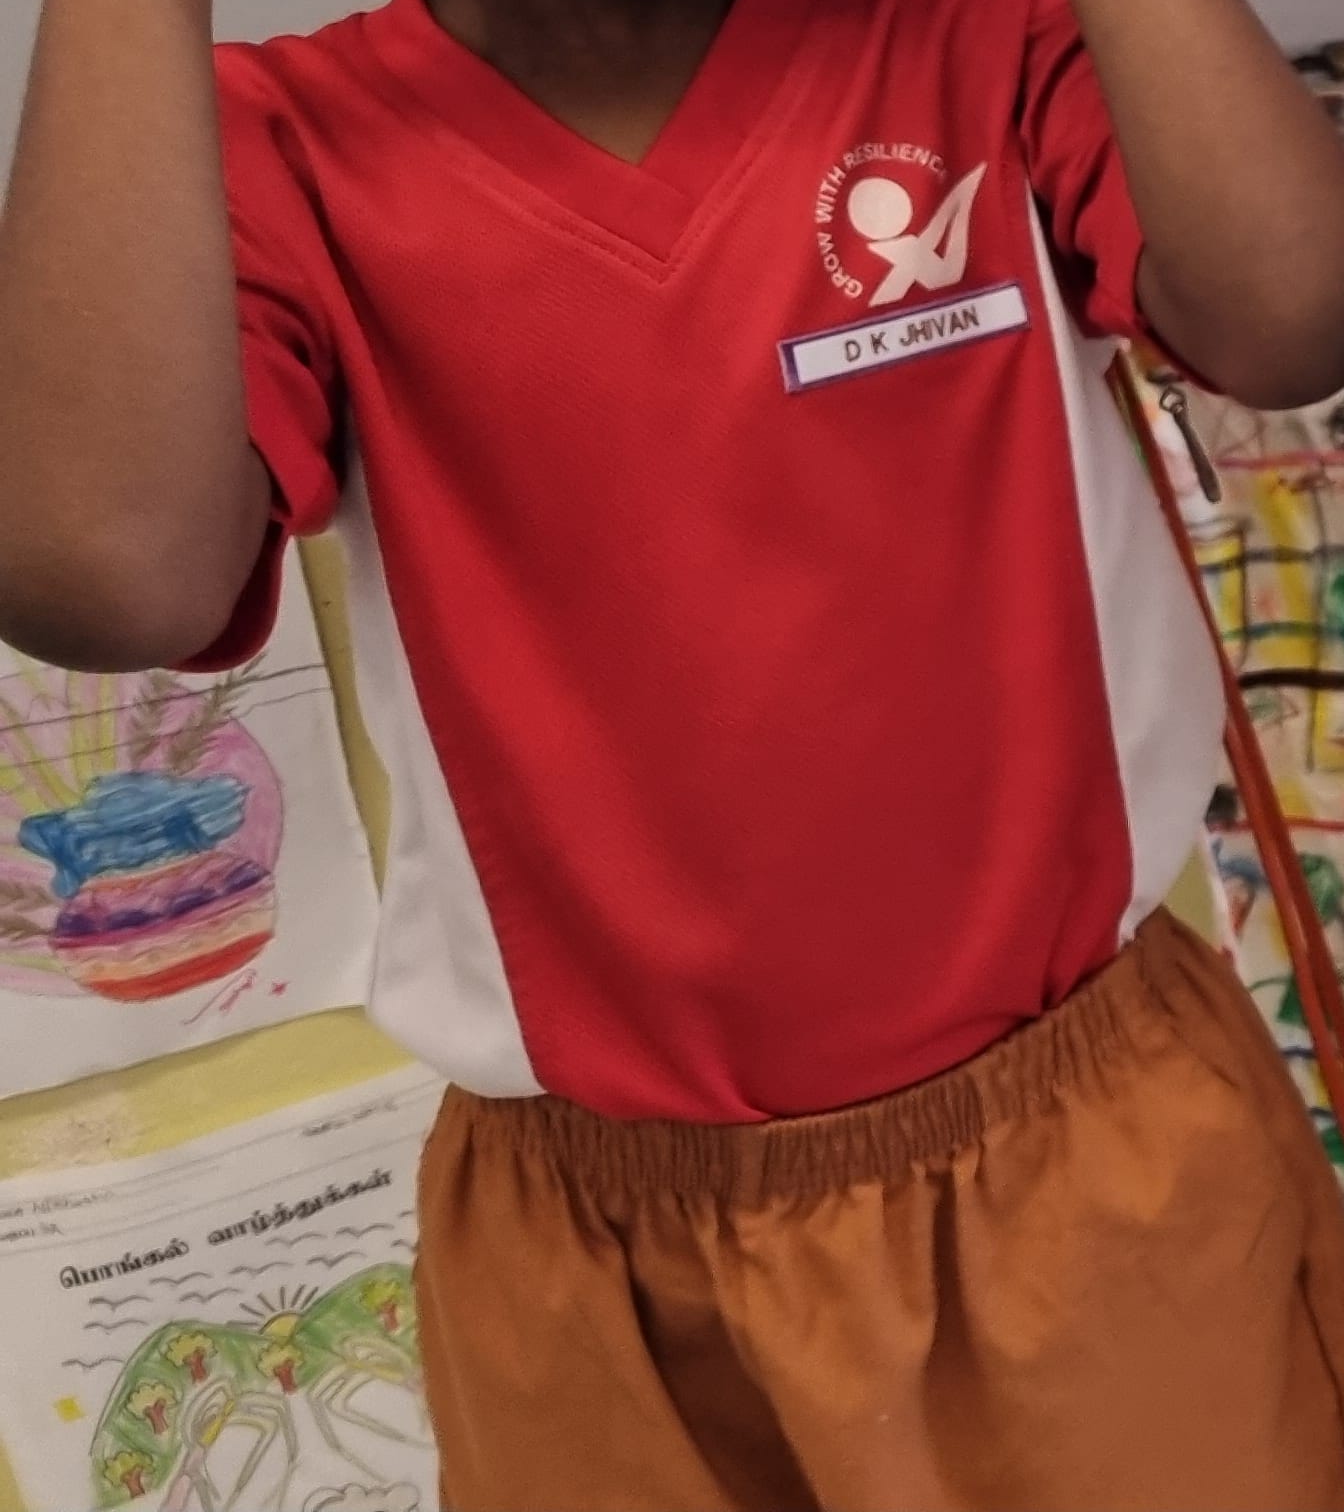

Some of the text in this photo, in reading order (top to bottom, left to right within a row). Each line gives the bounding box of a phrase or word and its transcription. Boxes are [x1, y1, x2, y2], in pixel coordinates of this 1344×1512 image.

[815, 168, 848, 225] WITH
[816, 231, 863, 300] GROW
[844, 306, 980, 362] D K JHIVAN
[59, 1237, 191, 1289] பொங்கல்
